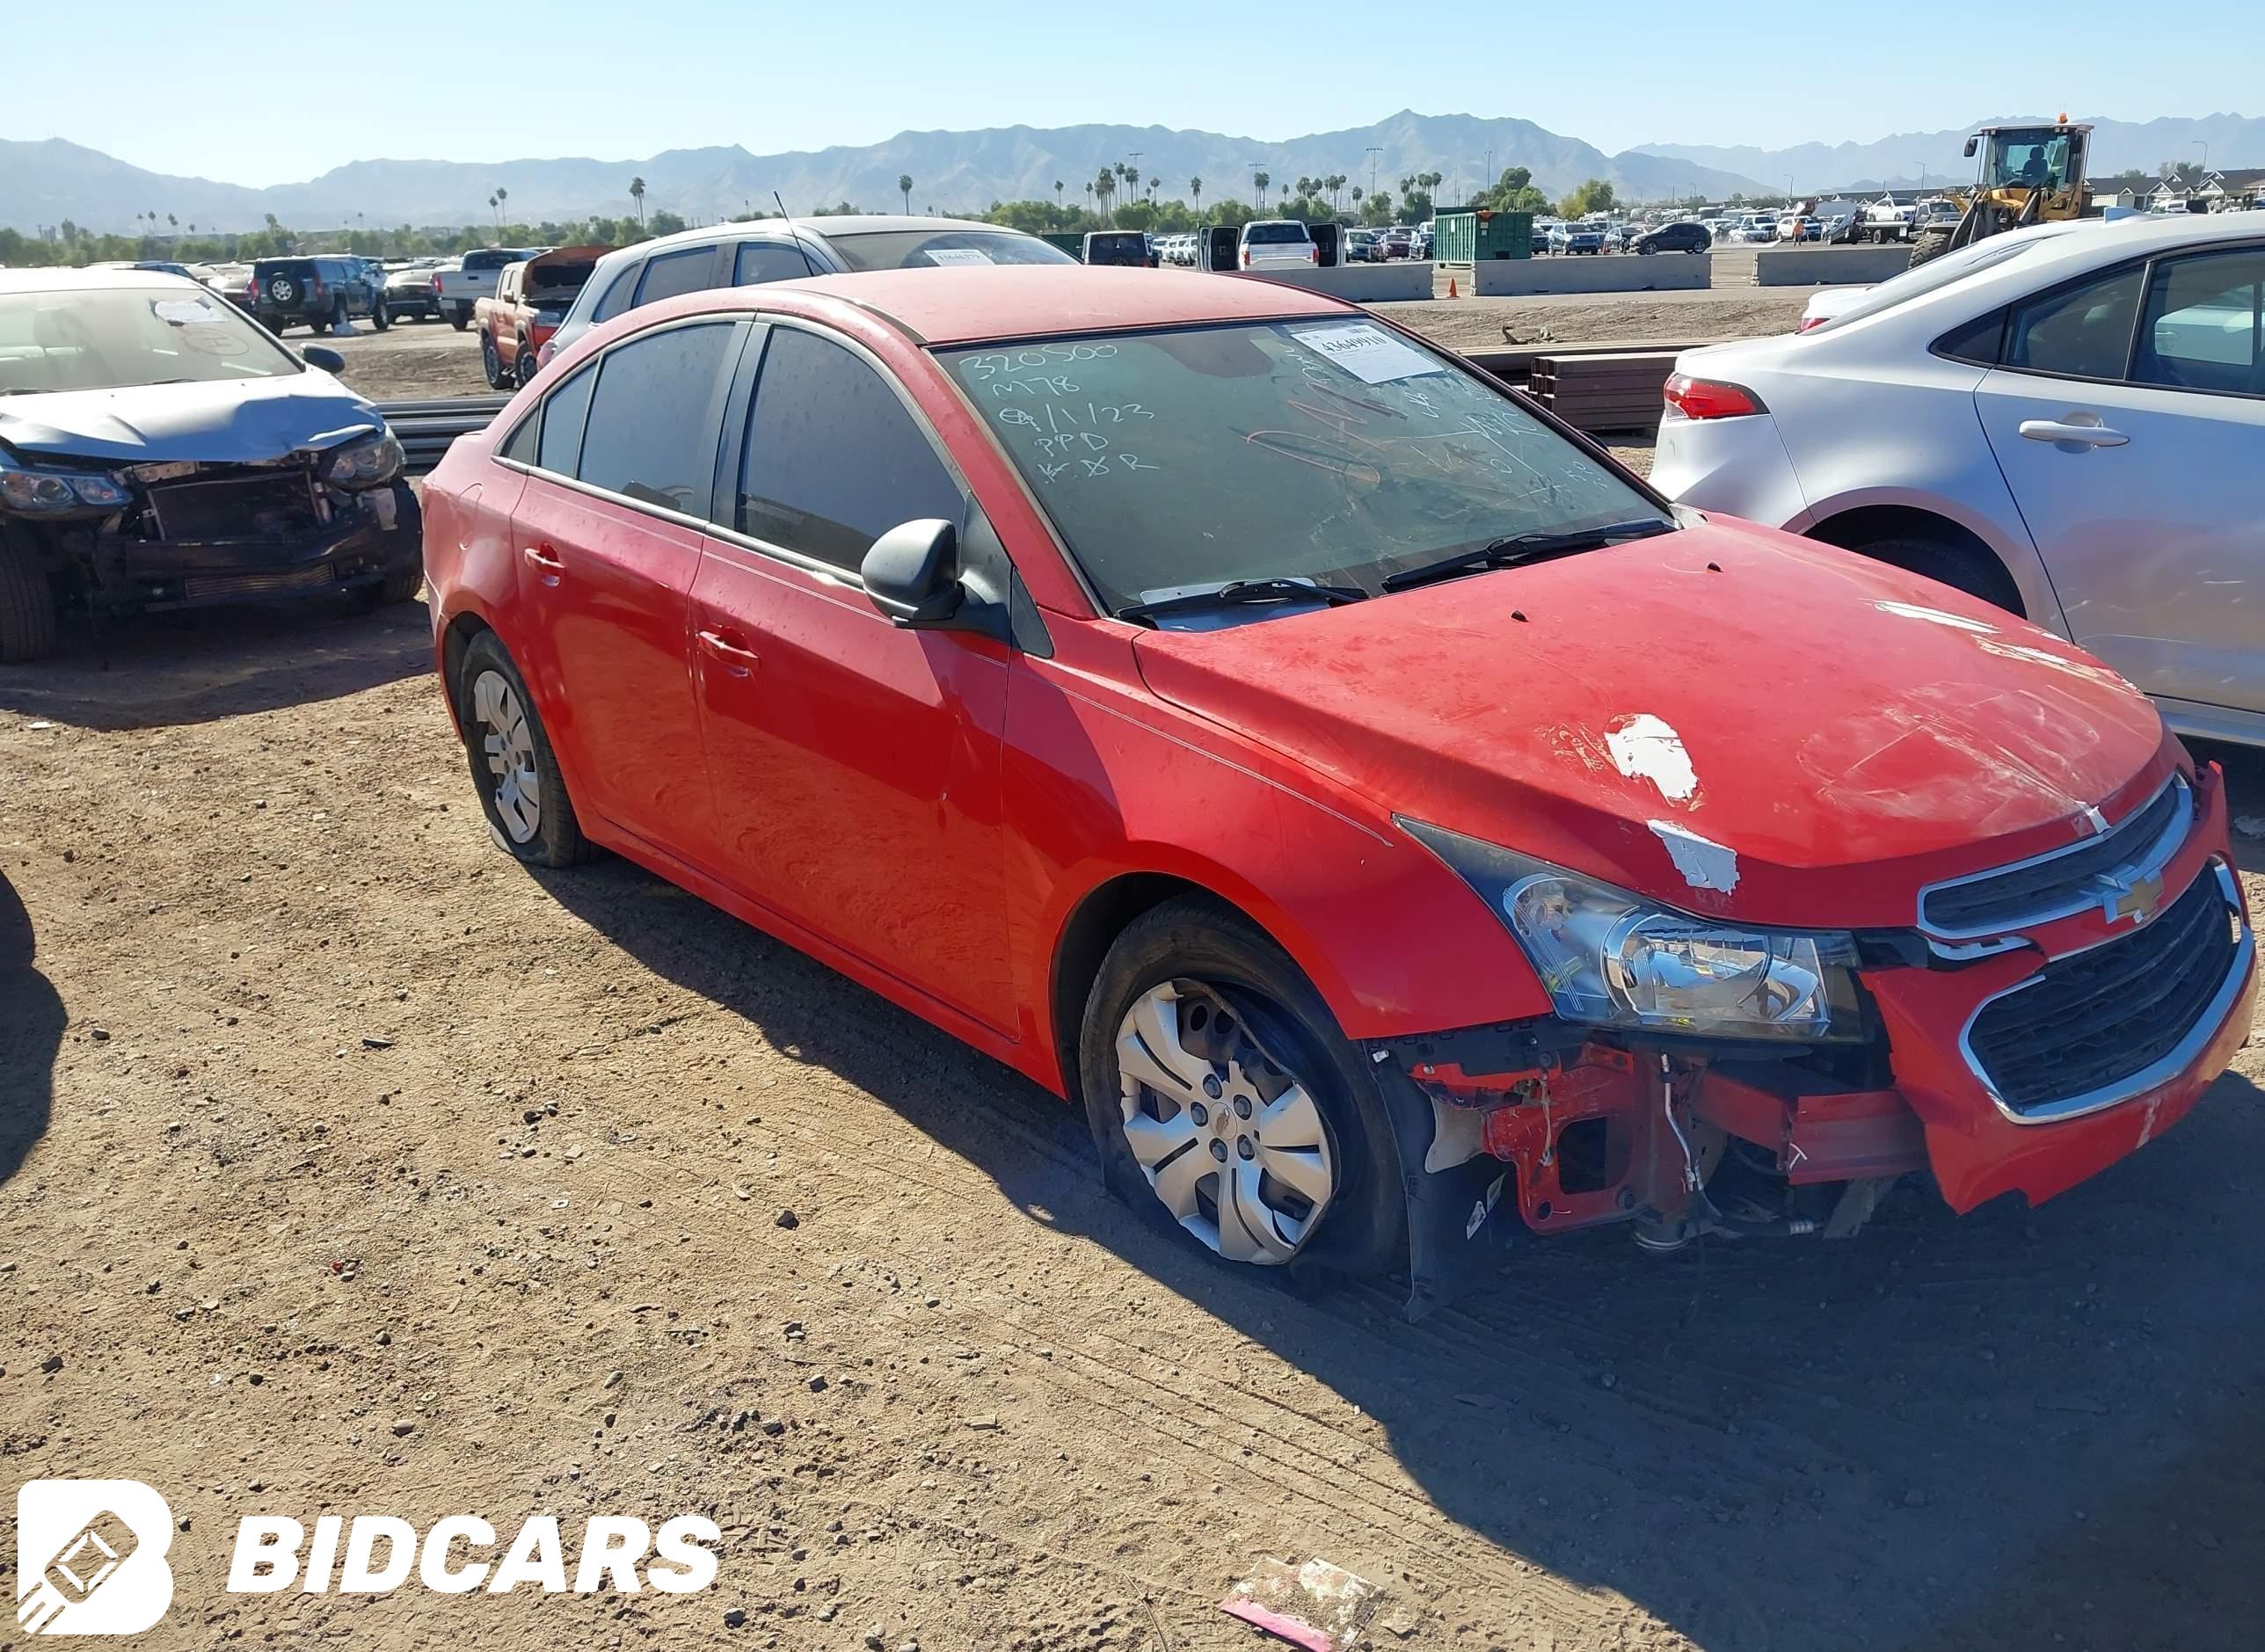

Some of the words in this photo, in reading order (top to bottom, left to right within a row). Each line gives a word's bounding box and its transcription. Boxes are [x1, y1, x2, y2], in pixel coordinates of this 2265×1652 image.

[1321, 335, 1387, 352] 43649910
[958, 345, 1118, 380] 320500
[992, 375, 1081, 397] M78
